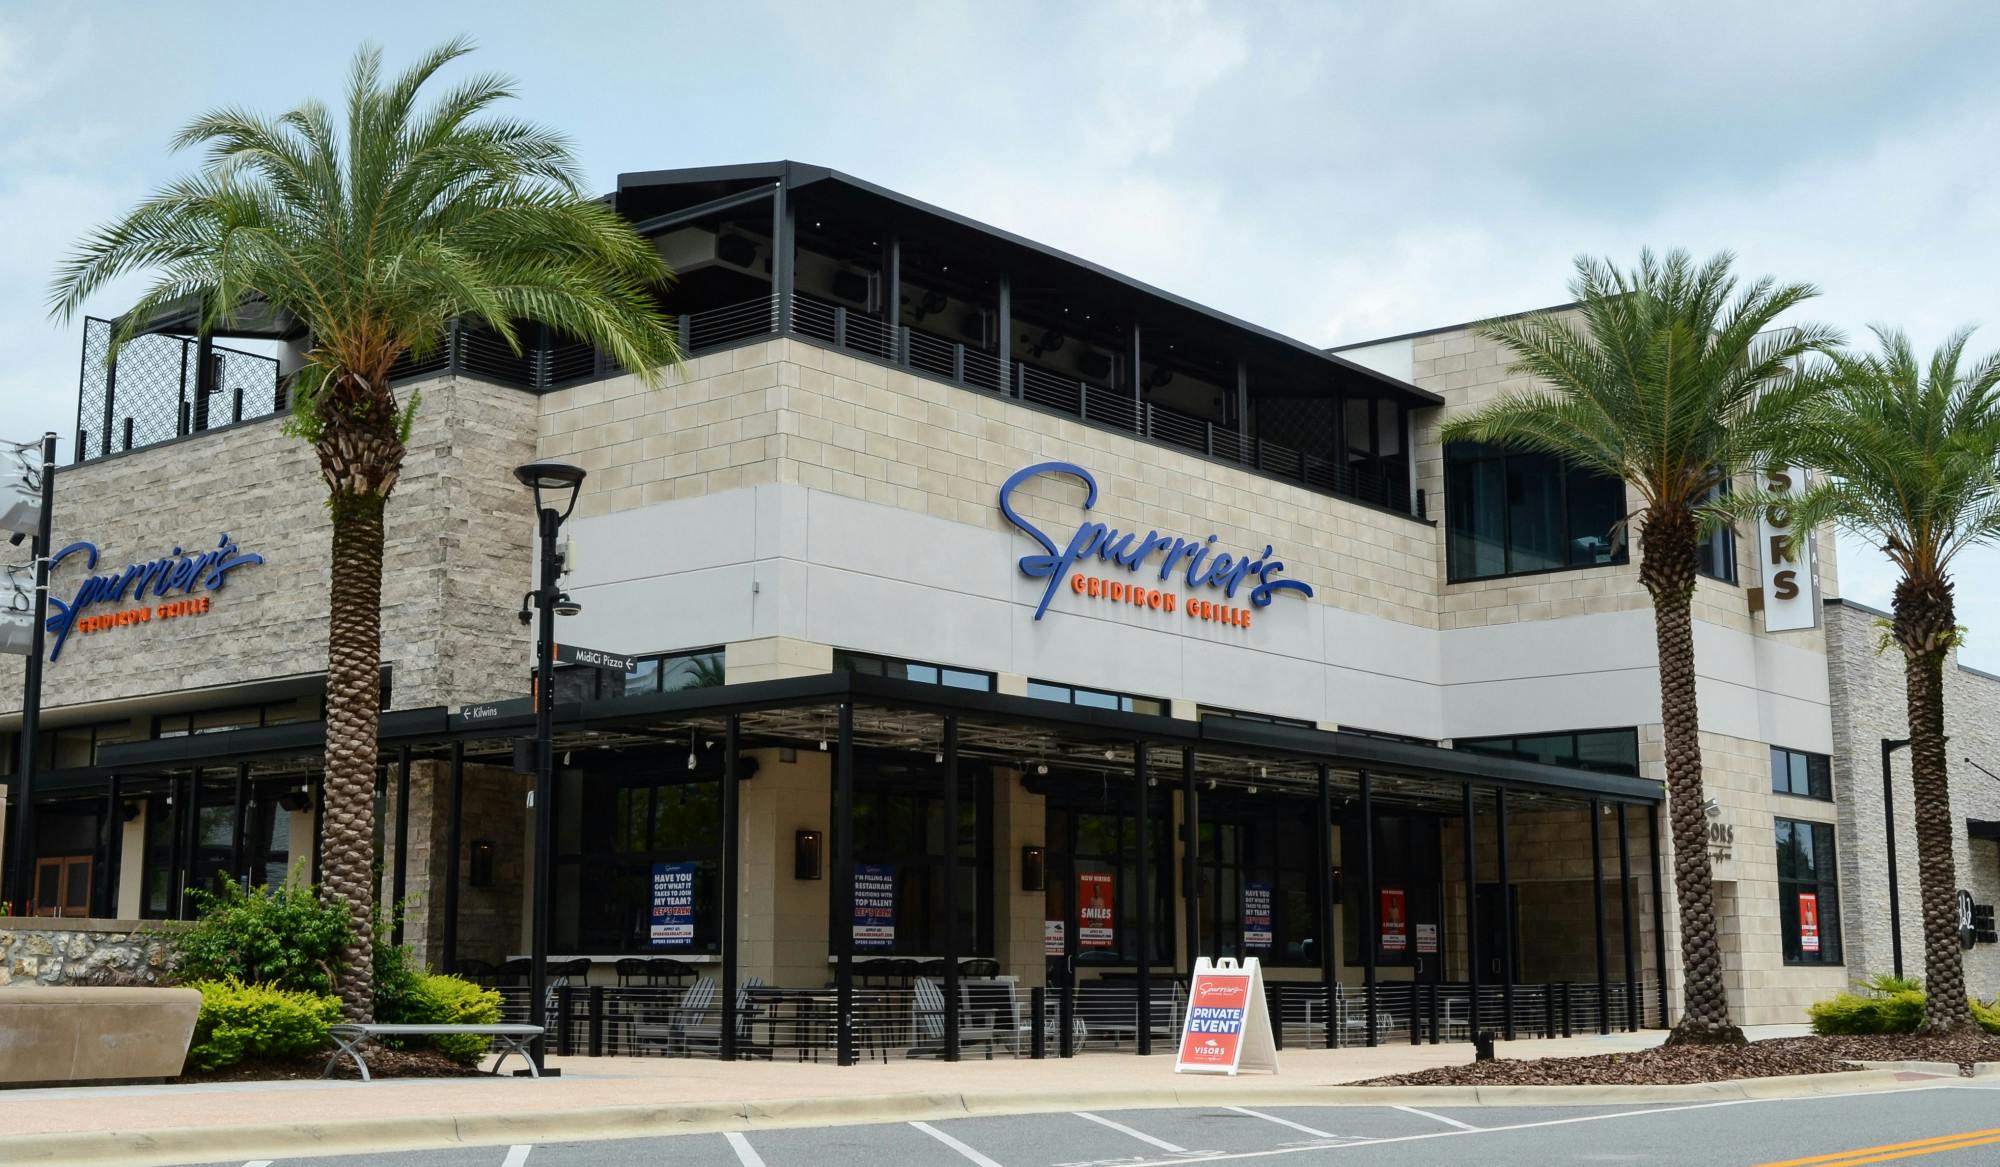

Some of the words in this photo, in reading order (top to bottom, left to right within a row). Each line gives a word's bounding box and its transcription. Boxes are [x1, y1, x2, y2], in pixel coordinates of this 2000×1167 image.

[1000, 461, 1314, 621] Spurrier's
[46, 533, 265, 662] Spurrier's
[1071, 573, 1176, 613] GRIDIRON
[1186, 597, 1251, 629] GRILLE
[78, 607, 151, 633] GRIDIRON
[156, 597, 210, 619] GRILLE
[576, 650, 600, 664] MidiCi
[603, 656, 623, 668] Pizza
[473, 706, 497, 718] Kilwins
[654, 874, 674, 882] HAVE
[675, 873, 692, 881] YOU
[654, 898, 666, 906] MY
[667, 897, 691, 905] TEAM?
[869, 899, 892, 907] TALENT
[1081, 908, 1111, 919] SMILES
[1194, 1008, 1240, 1019] PRIVATE
[1190, 1020, 1239, 1033] EVENT
[1194, 1046, 1225, 1055] VISORS
